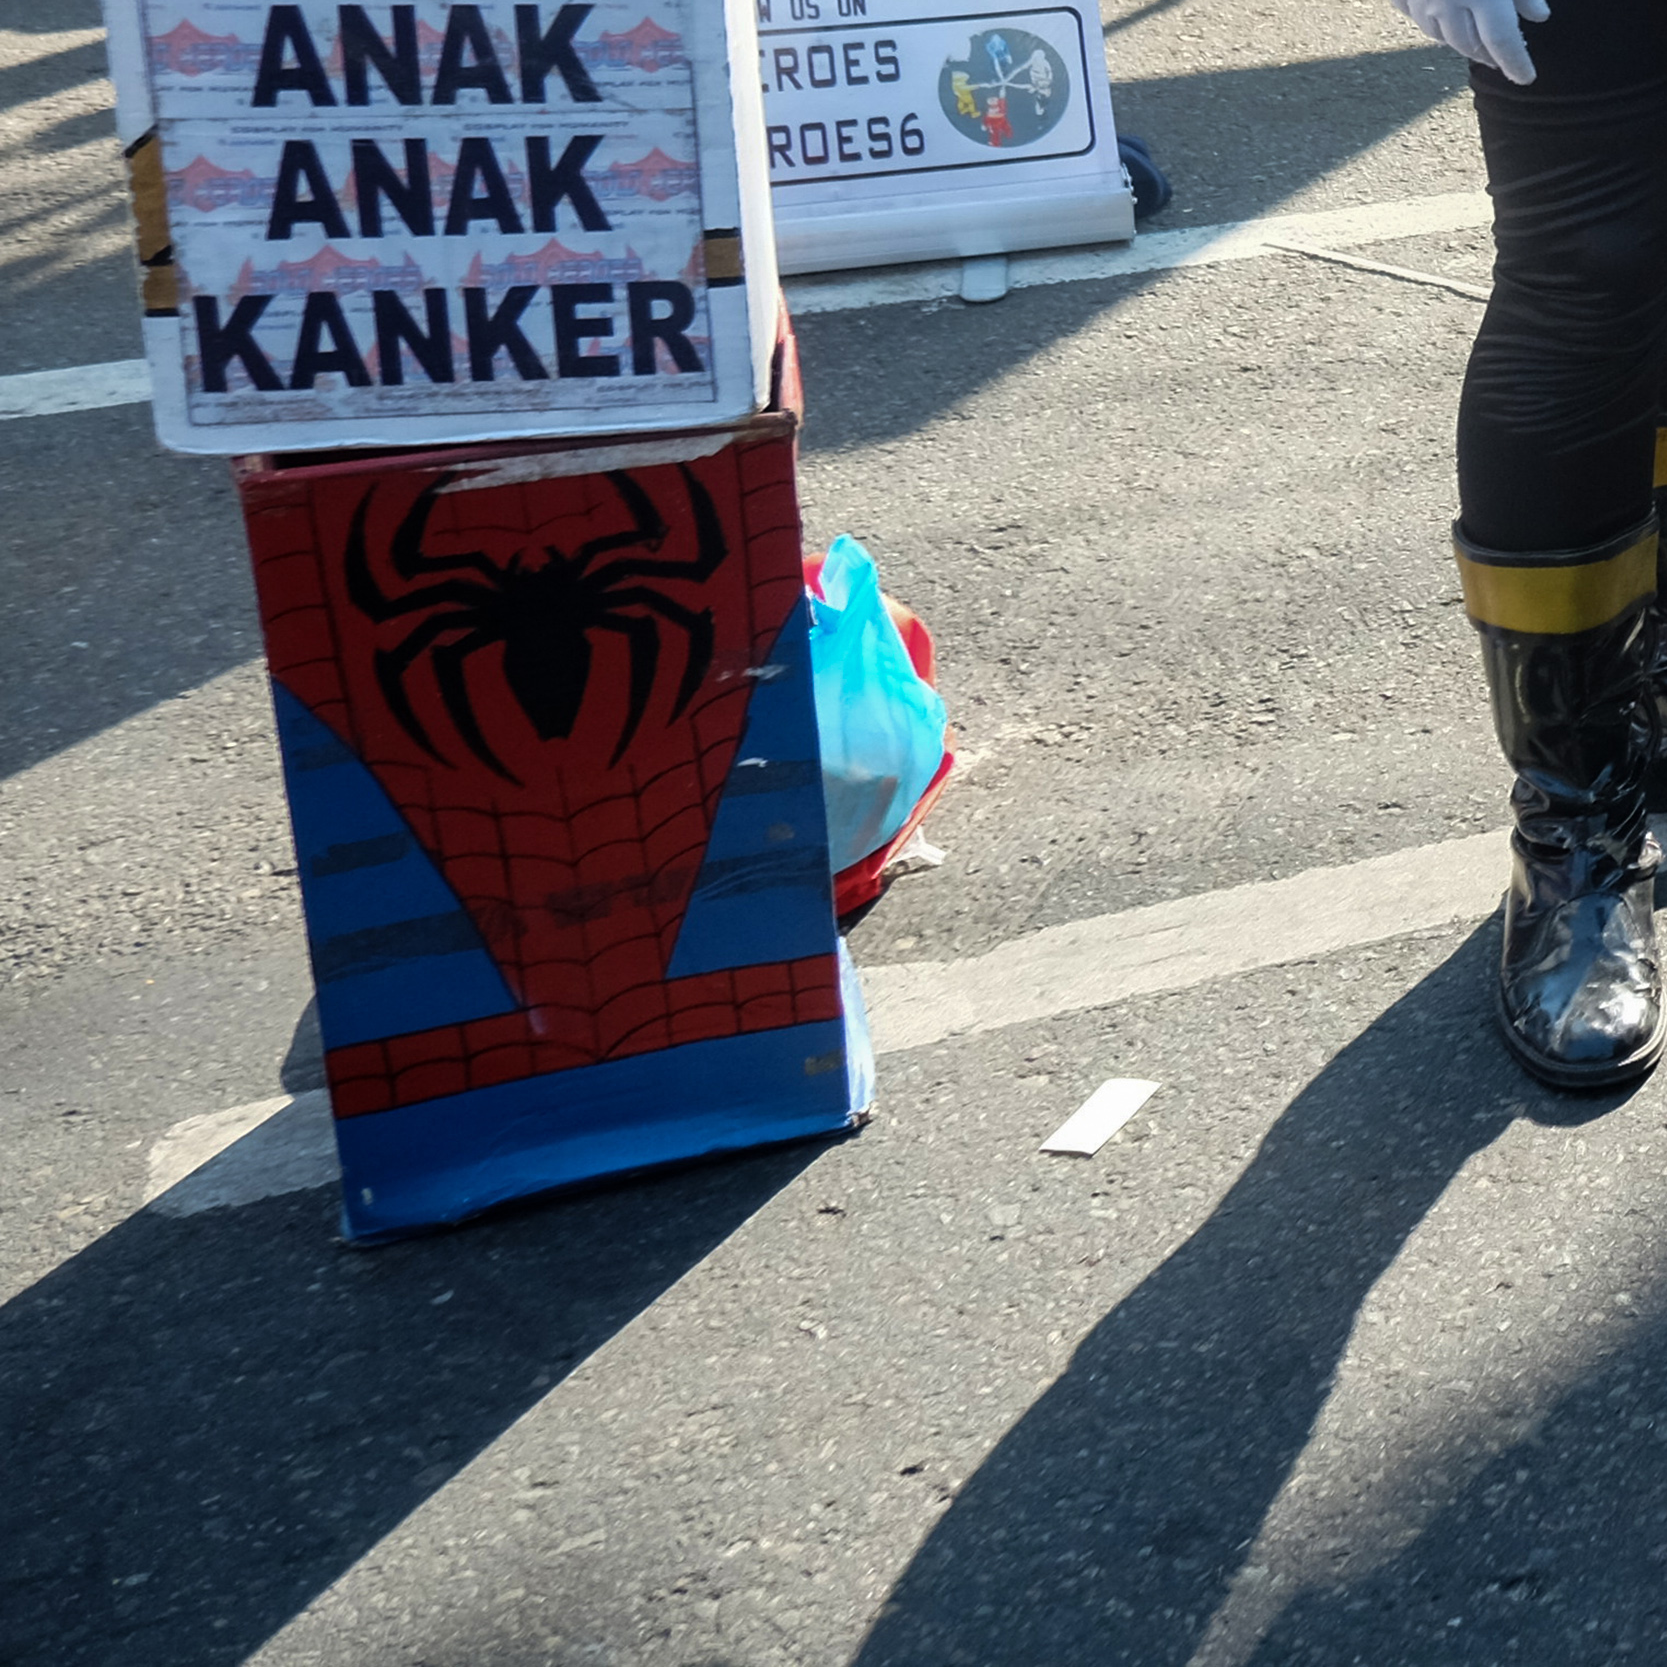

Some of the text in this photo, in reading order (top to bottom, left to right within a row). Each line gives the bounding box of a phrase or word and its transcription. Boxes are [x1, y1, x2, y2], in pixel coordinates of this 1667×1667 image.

[252, 4, 603, 108] ANAK
[759, 39, 901, 93] ROES
[265, 135, 613, 240] ANAK
[767, 113, 925, 169] ROES6
[192, 280, 705, 393] KANKER
